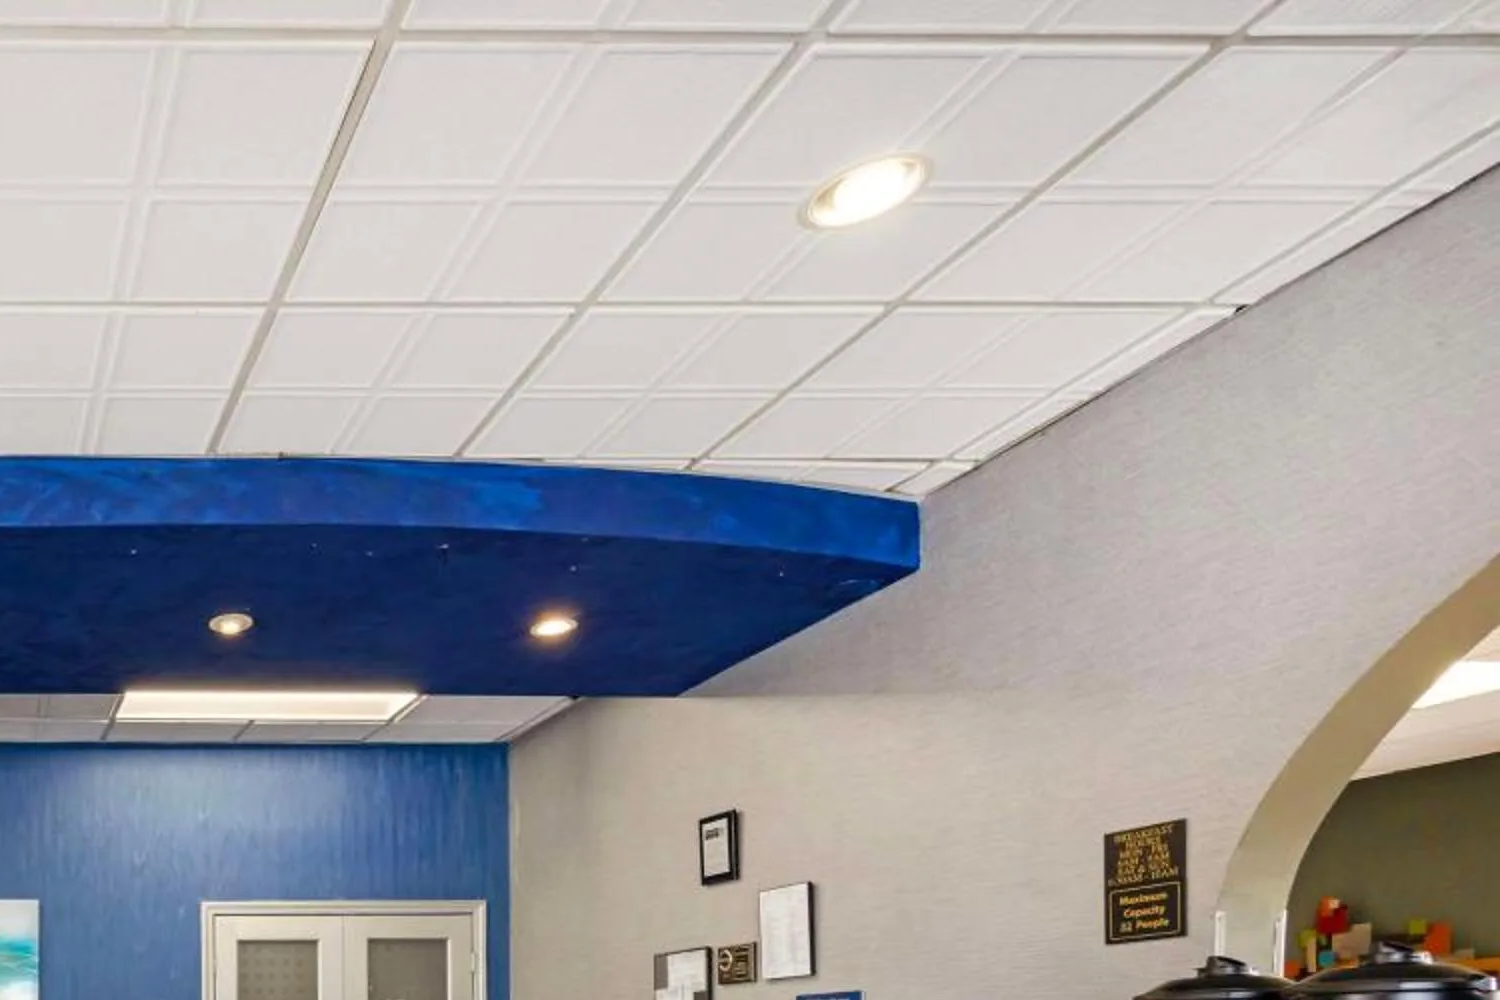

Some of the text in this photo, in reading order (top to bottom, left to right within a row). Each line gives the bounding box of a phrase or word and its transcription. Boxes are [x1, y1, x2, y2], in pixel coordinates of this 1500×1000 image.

[1119, 892, 1168, 905] Maximum
[1123, 905, 1166, 918] Capacity
[1135, 918, 1169, 930] People
